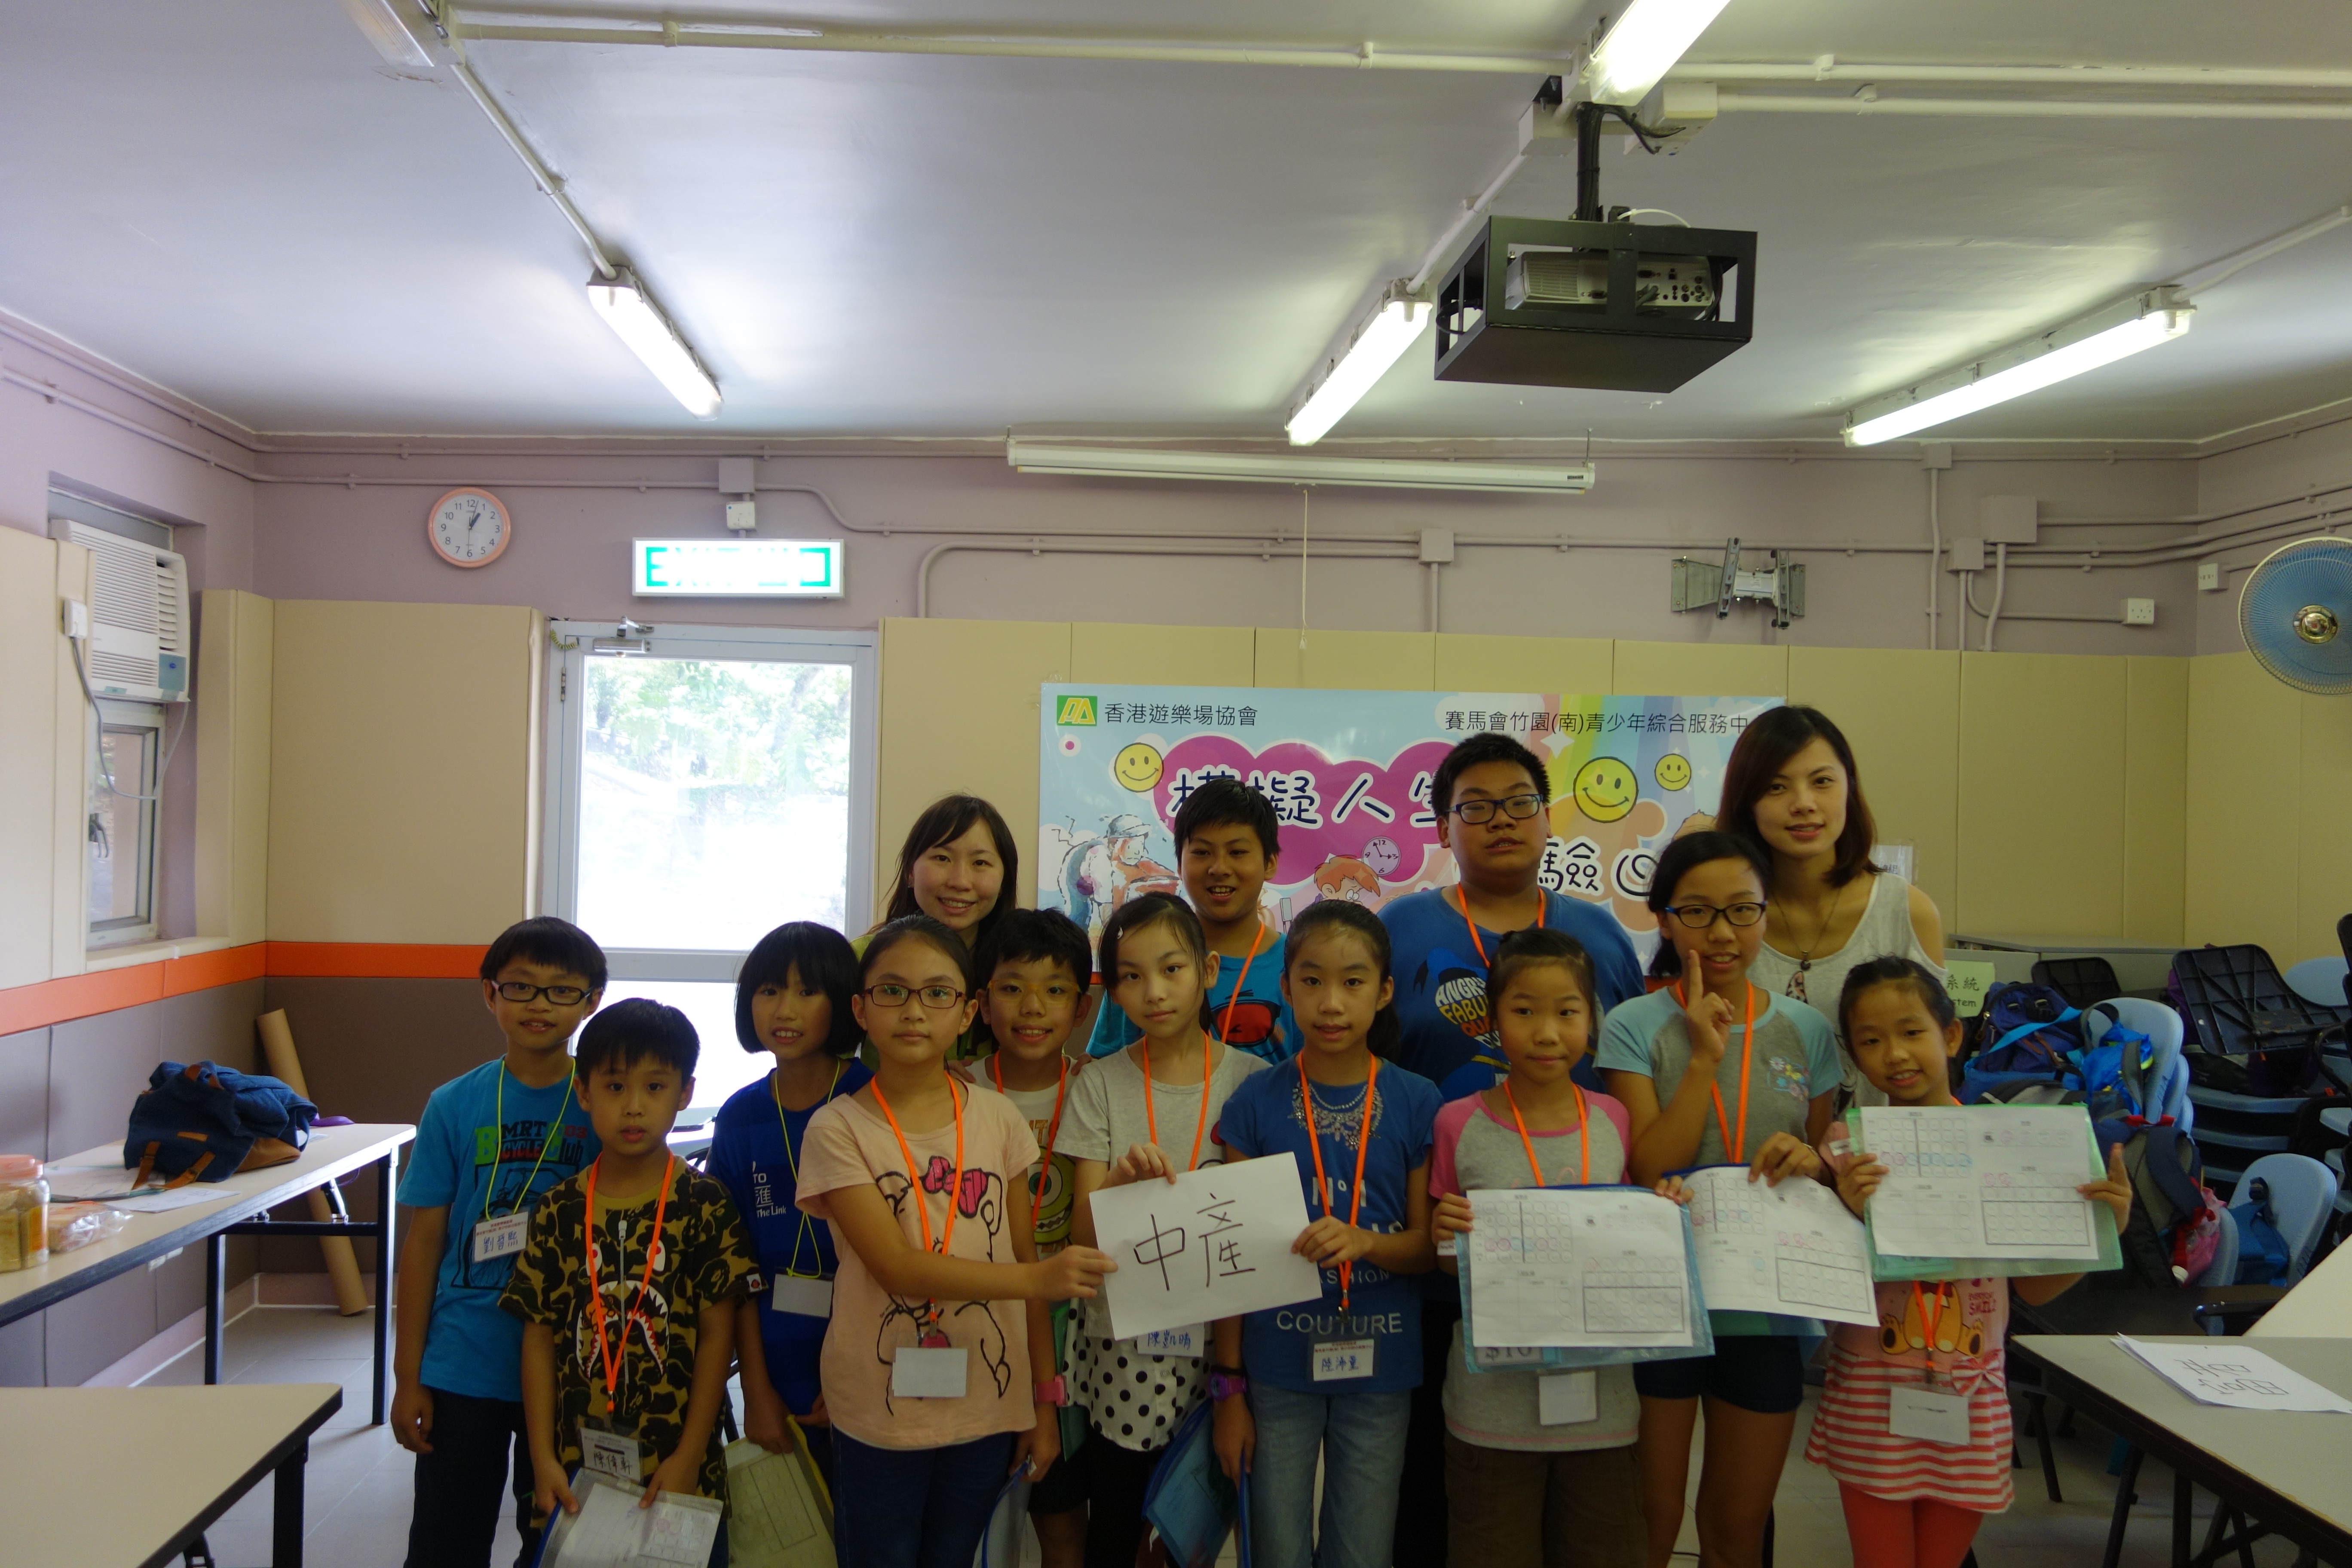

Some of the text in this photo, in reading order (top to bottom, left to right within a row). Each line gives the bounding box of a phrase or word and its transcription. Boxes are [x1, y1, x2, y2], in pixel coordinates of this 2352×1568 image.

[467, 499, 475, 507] 12
[444, 511, 454, 520] 10
[490, 511, 495, 519] 2
[441, 523, 446, 532] 9
[495, 525, 500, 533] 3
[445, 536, 451, 545] 8
[455, 545, 460, 554] 7
[481, 546, 486, 554] 5
[1104, 702, 1258, 726] 香港遊樂場協會
[1445, 710, 1748, 734] 賽馬會竹園(南)青少年綜合服務中
[1952, 998, 1977, 1007] tem
[756, 1204, 787, 1219] The Link
[1133, 1192, 1256, 1292] 中產
[1276, 1310, 1403, 1335] COUTURE
